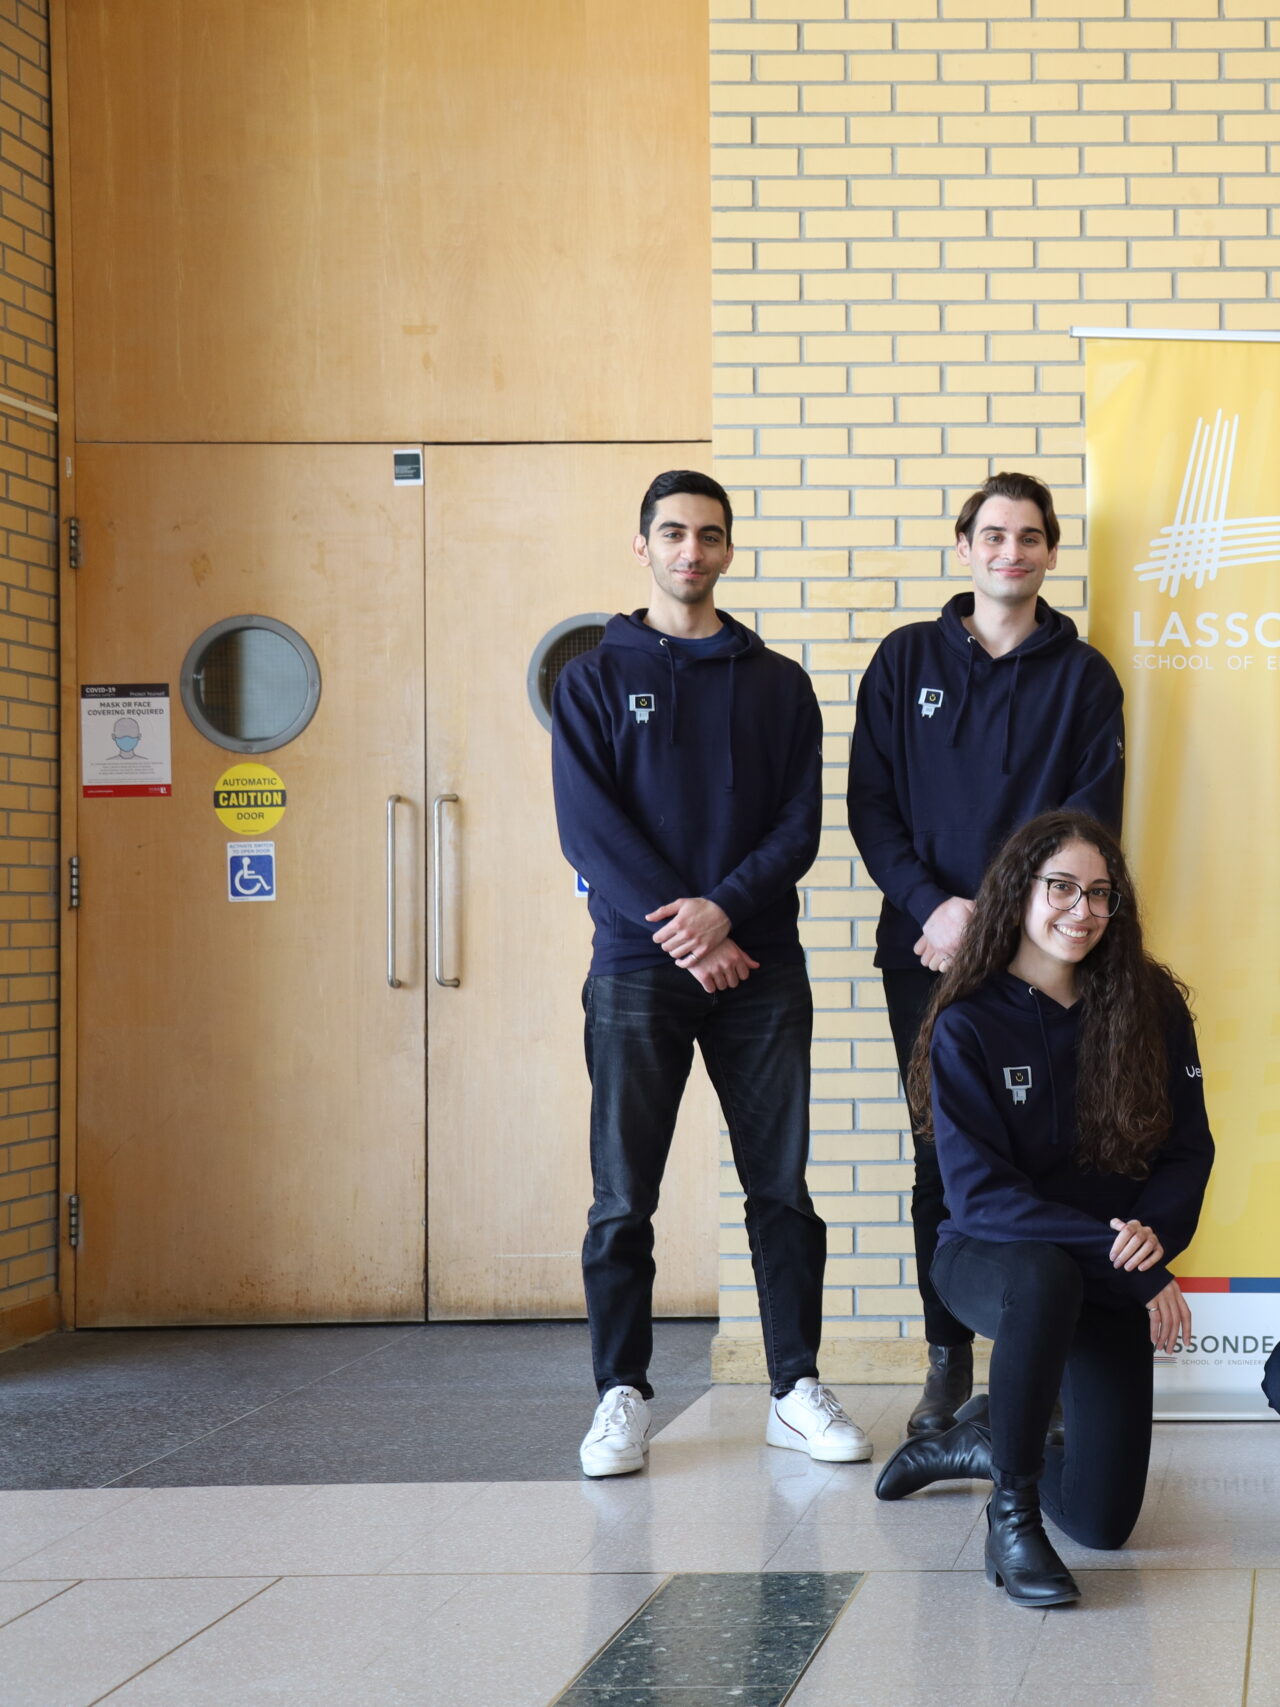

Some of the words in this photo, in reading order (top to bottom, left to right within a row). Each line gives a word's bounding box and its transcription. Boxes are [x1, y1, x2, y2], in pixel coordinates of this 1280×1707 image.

[1132, 654, 1213, 670] SCHOOL
[1227, 655, 1254, 670] OF
[222, 778, 277, 786] AUTOMATIC
[219, 791, 282, 806] CAUTION
[236, 812, 265, 820] DOOR
[1185, 1065, 1202, 1078] Ve
[1153, 1335, 1274, 1354] SSONDE
